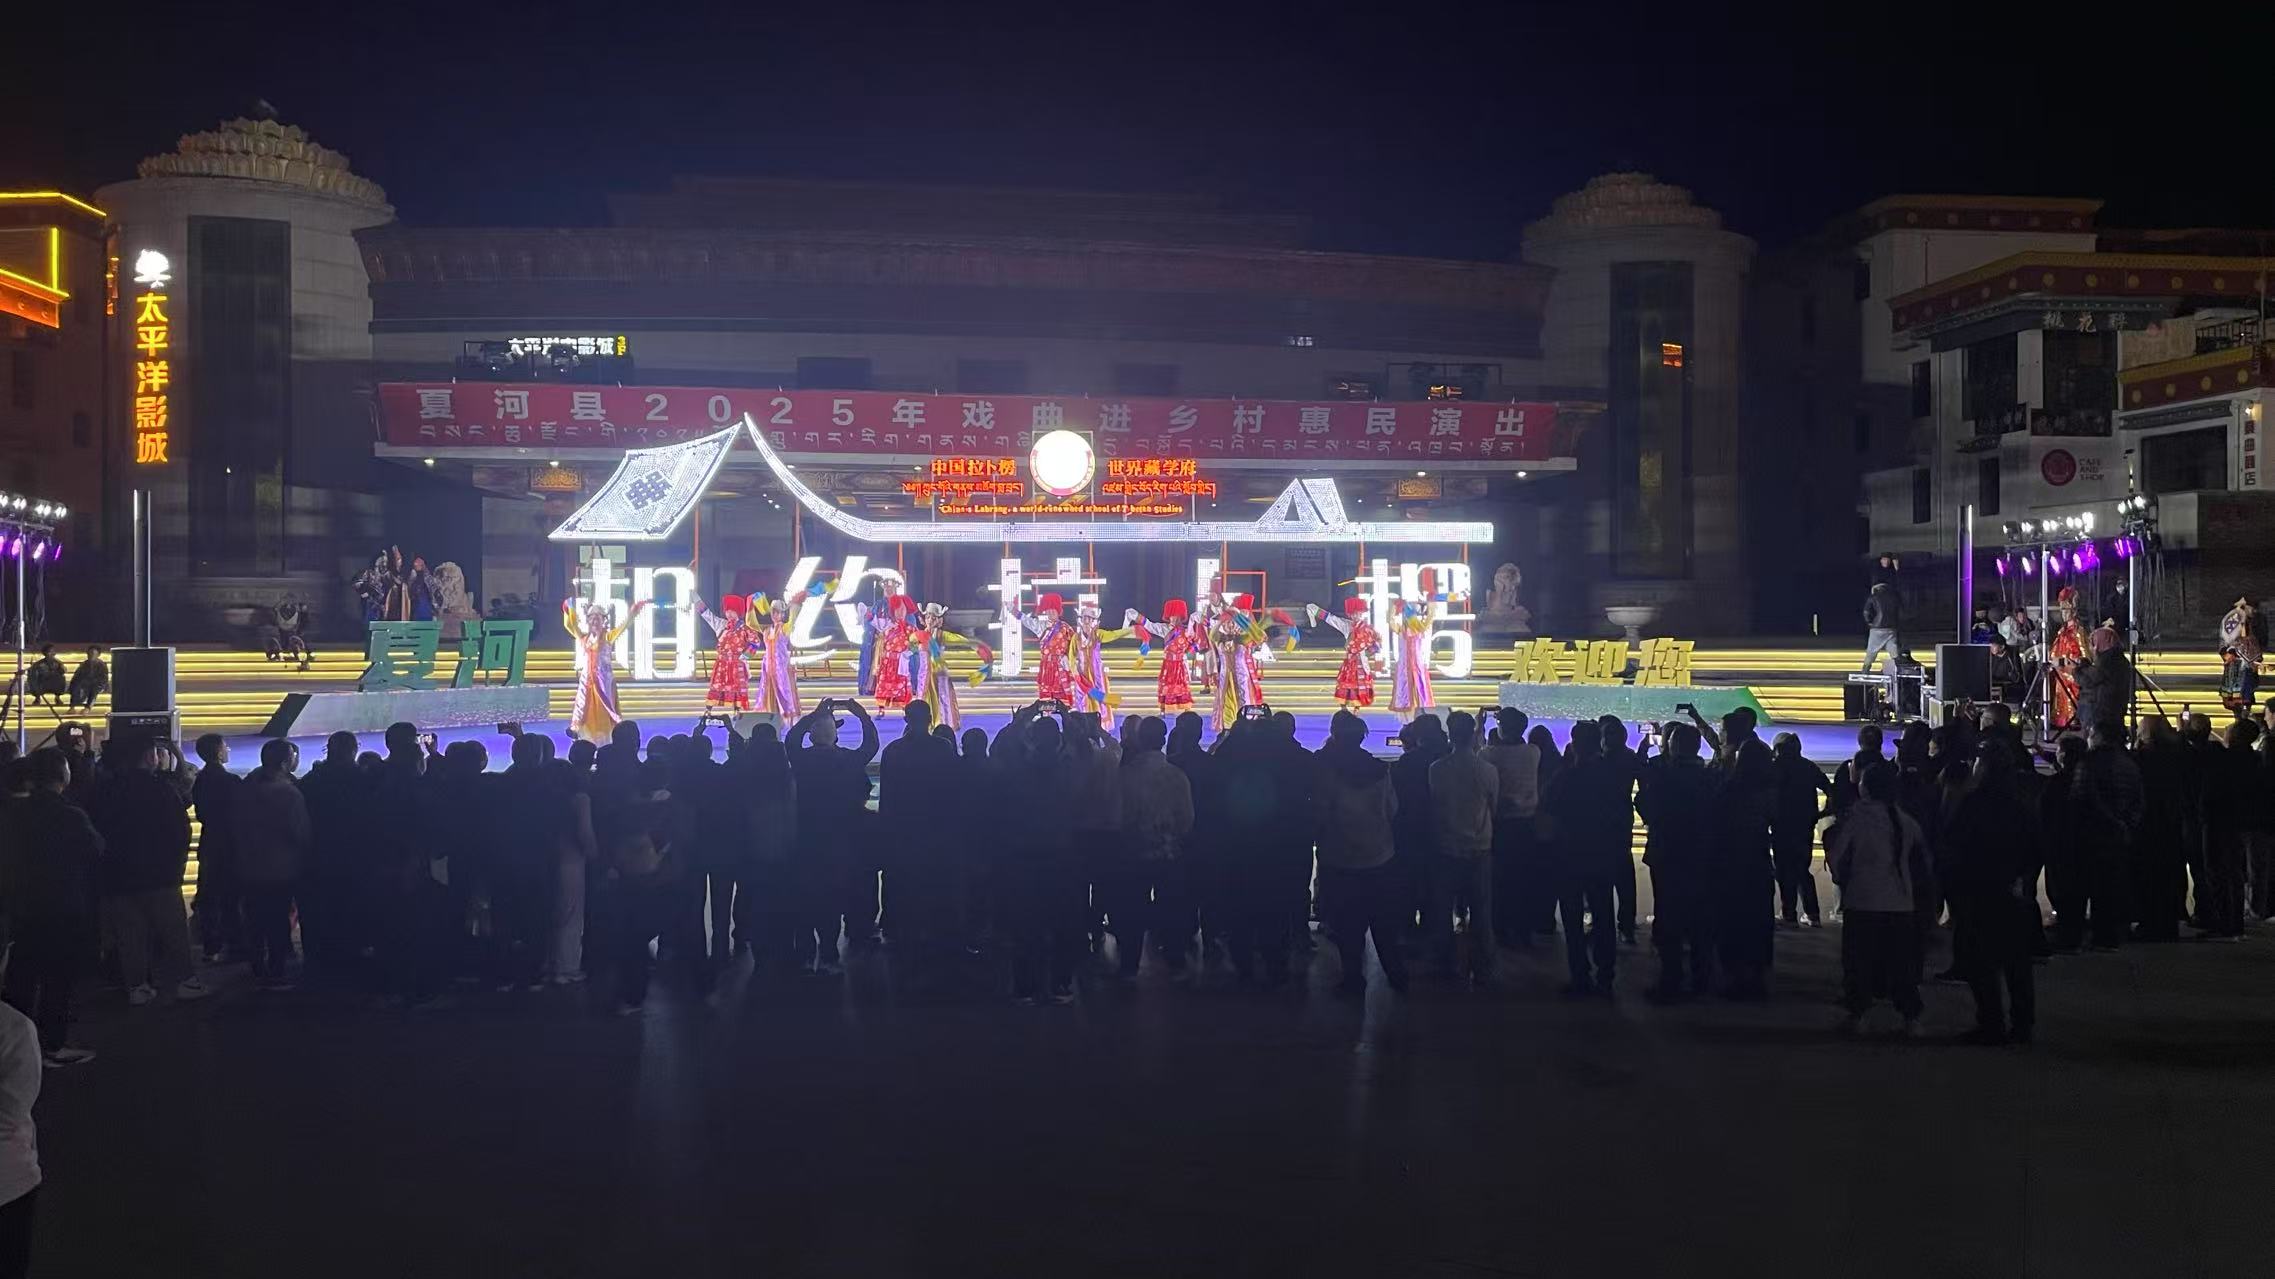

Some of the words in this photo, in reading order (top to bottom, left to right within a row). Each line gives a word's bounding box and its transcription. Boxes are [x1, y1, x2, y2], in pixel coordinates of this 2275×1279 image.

[136, 292, 169, 463] 太平洋影城
[416, 388, 1526, 437] 夏河县2025年戏曲进乡村惠民演出
[931, 457, 1017, 476] 中国拉卜楞
[1108, 458, 1196, 476] 世界藏学府
[1085, 503, 1110, 513] school
[1111, 503, 1120, 513] of
[1122, 503, 1152, 513] Tbetan
[1154, 502, 1183, 514] Studies
[358, 620, 534, 692] 夏河
[1509, 637, 1696, 687] 欢迎您
